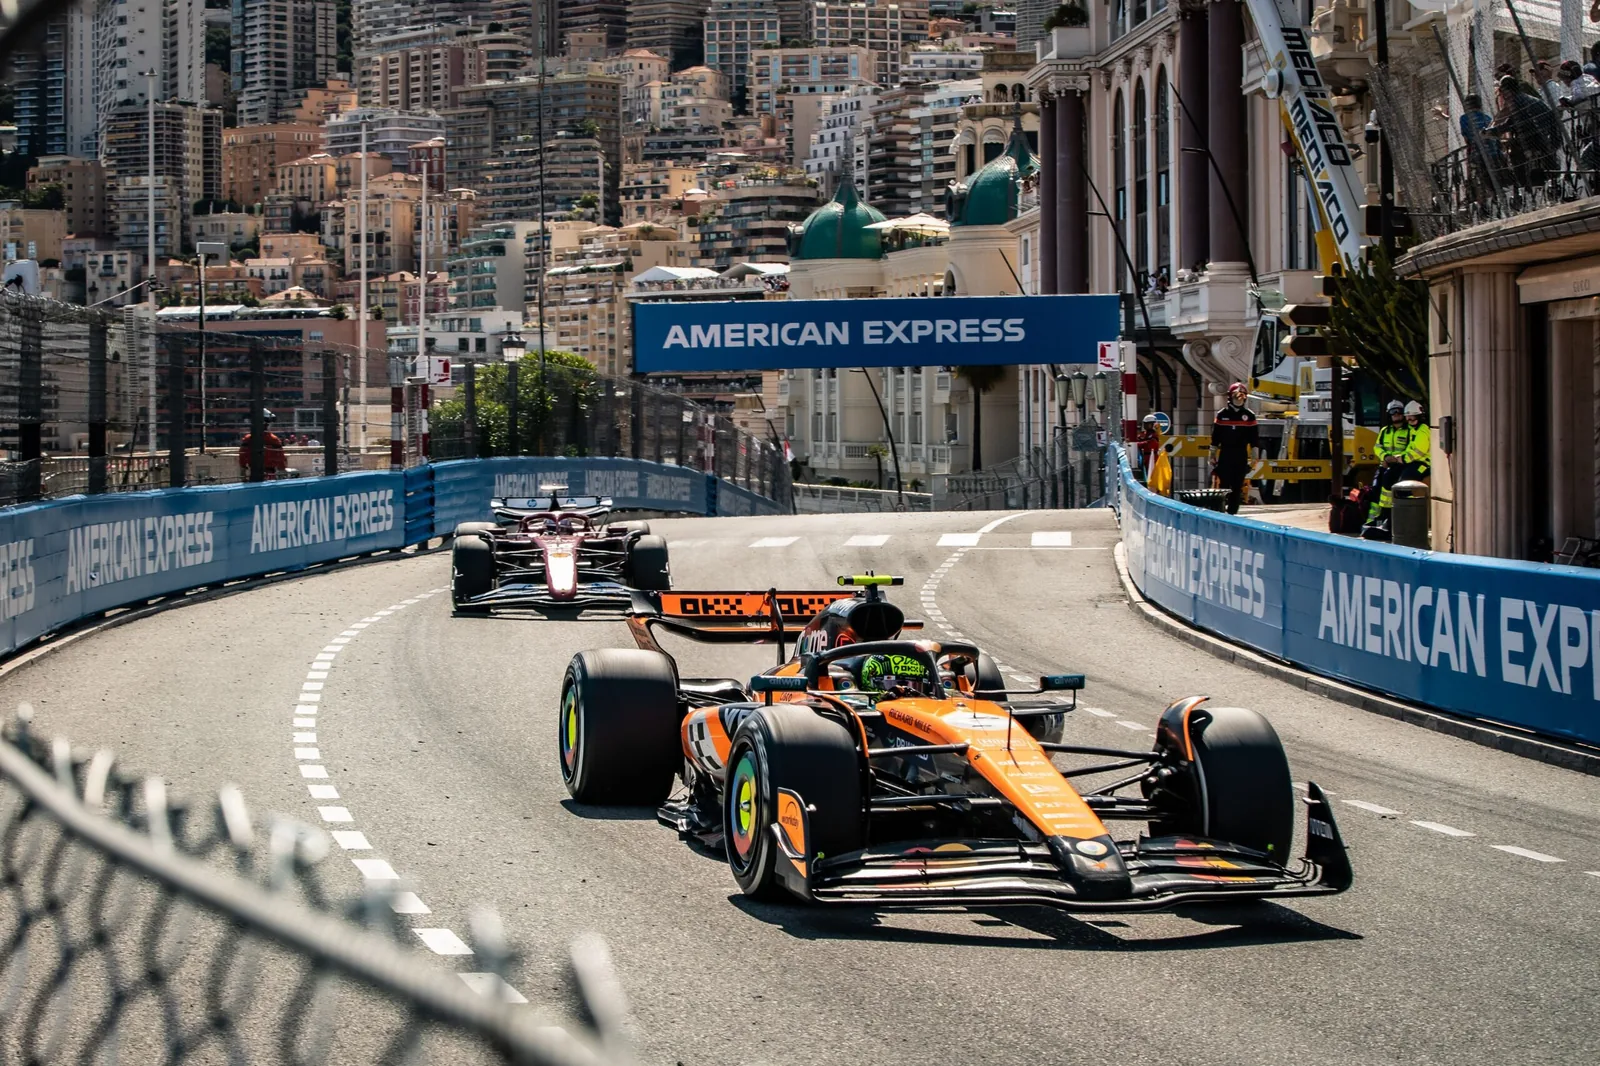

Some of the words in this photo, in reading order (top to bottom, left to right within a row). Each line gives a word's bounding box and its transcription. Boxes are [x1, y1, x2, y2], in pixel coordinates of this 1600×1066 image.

[662, 321, 850, 349] AMERICAN
[862, 318, 1026, 345] EXPRESS
[66, 517, 142, 596] AMERICAN
[144, 511, 214, 574] EXPRESS
[251, 499, 331, 554] AMERICAN
[333, 489, 393, 540] EXPRESS
[680, 598, 743, 615] OKX
[1188, 533, 1266, 619] EXPRESS
[1317, 569, 1486, 678] AMERICAN
[888, 708, 914, 726] RICHARD
[914, 718, 932, 734] MILLE
